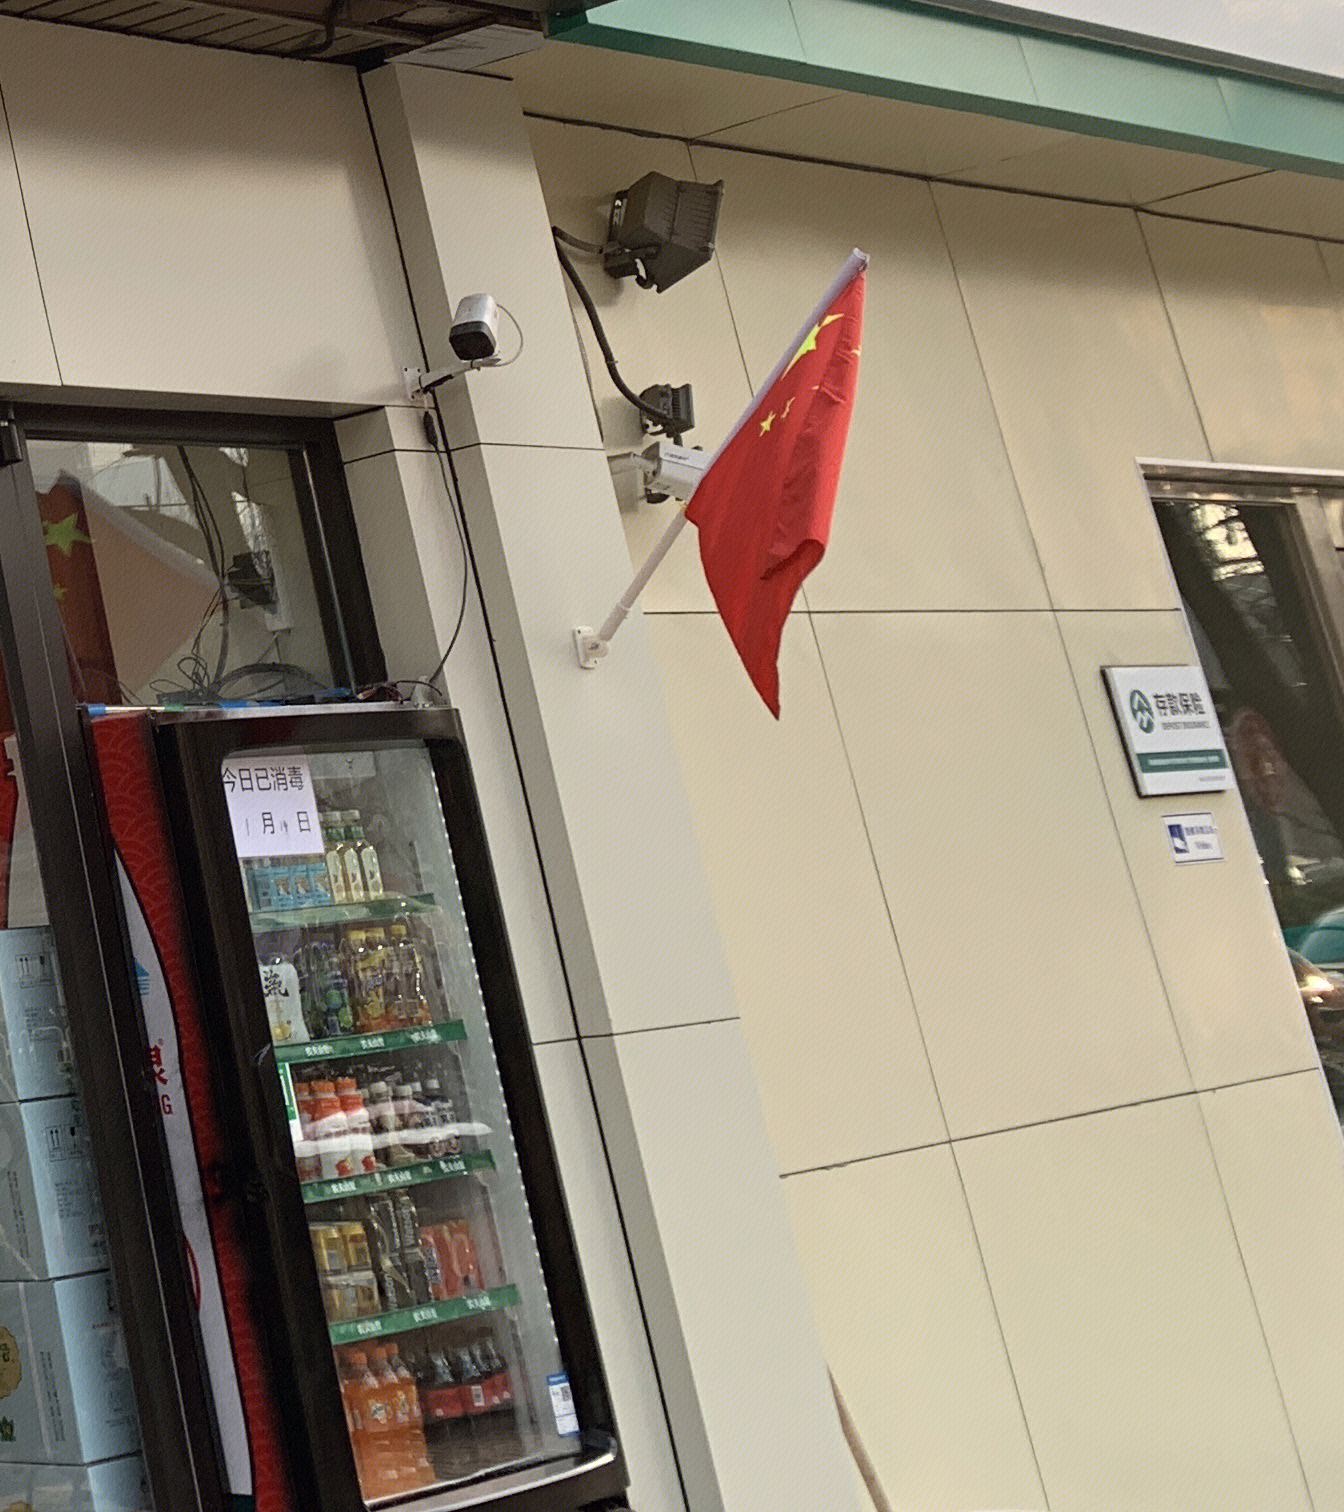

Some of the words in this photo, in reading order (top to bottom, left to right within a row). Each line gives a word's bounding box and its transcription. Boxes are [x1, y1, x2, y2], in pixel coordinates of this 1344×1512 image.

[1152, 691, 1206, 716] 存款保险
[222, 766, 304, 792] 今日已消毒
